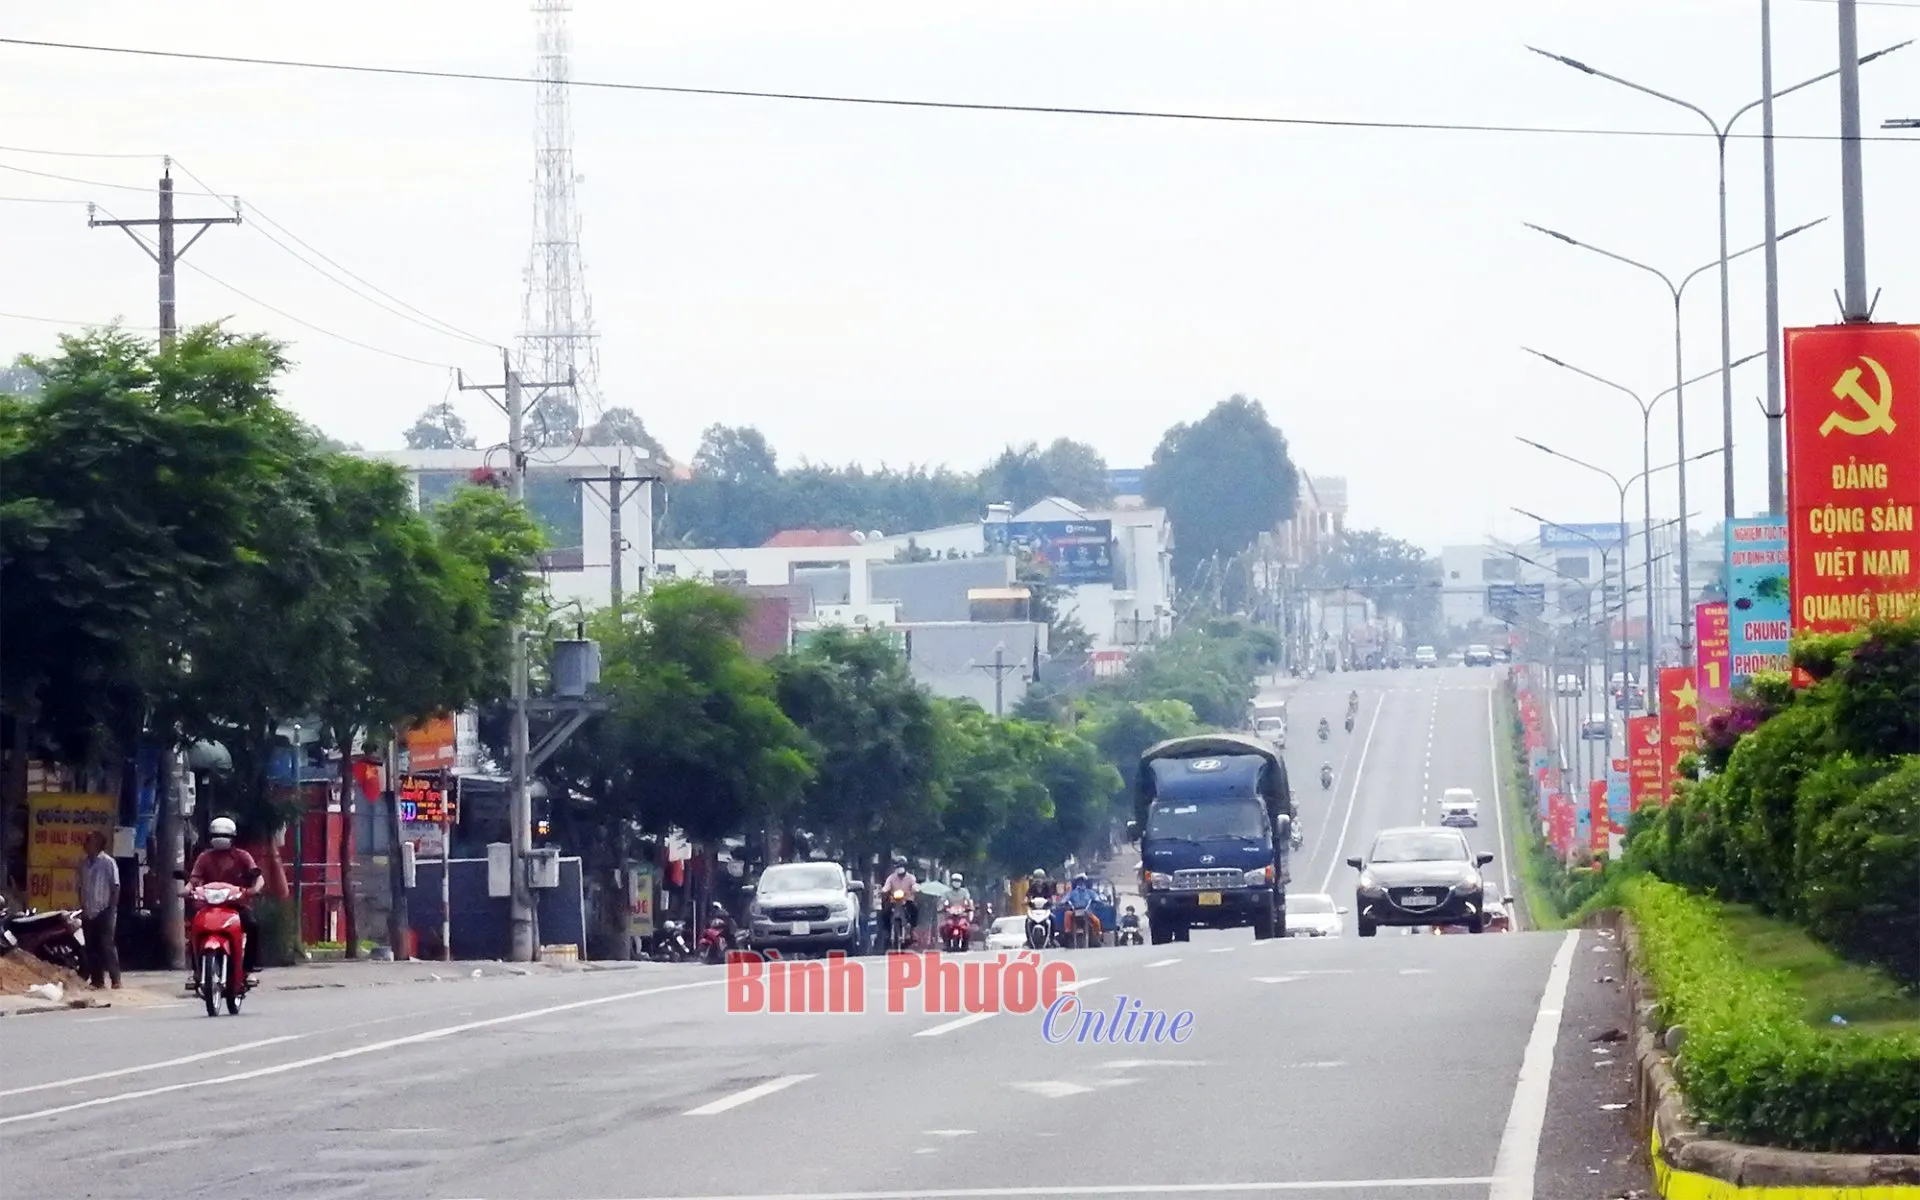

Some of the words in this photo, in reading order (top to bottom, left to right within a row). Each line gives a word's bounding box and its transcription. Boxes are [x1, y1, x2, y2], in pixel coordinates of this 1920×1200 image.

[1832, 455, 1888, 489] ĐẢNG
[1809, 503, 1865, 539] CỘNG
[1871, 498, 1913, 532] SẢN
[1814, 546, 1856, 582] VIỆT
[1863, 549, 1910, 576] NAM
[1803, 593, 1870, 623] QUANG
[1745, 621, 1787, 641] CHUNG
